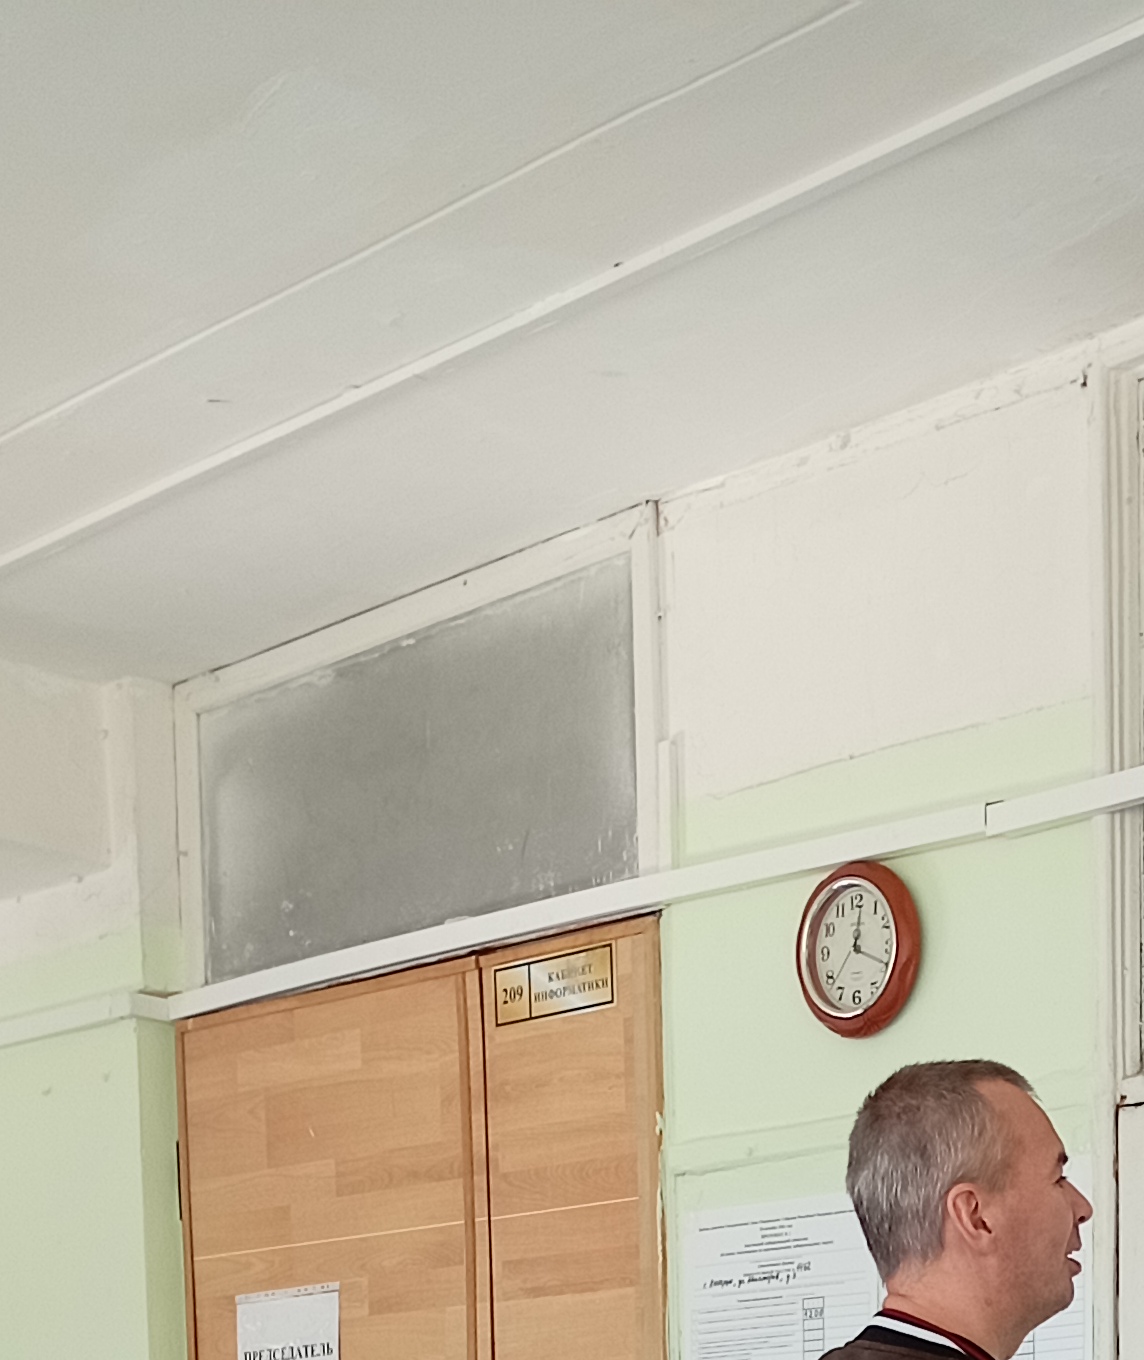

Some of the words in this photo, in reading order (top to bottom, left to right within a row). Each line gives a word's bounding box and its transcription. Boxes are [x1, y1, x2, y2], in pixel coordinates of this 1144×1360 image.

[850, 894, 863, 910] 12
[873, 900, 878, 915] 1
[836, 902, 845, 918] 11
[881, 914, 890, 929] 2
[824, 922, 835, 937] 10
[821, 946, 830, 962] 9
[826, 970, 836, 985] 8
[502, 985, 524, 1005] 209
[533, 977, 609, 1003] ИНФОРМАТИКИ
[836, 986, 845, 1001] 7
[870, 981, 879, 996] 5
[852, 990, 862, 1005] 6
